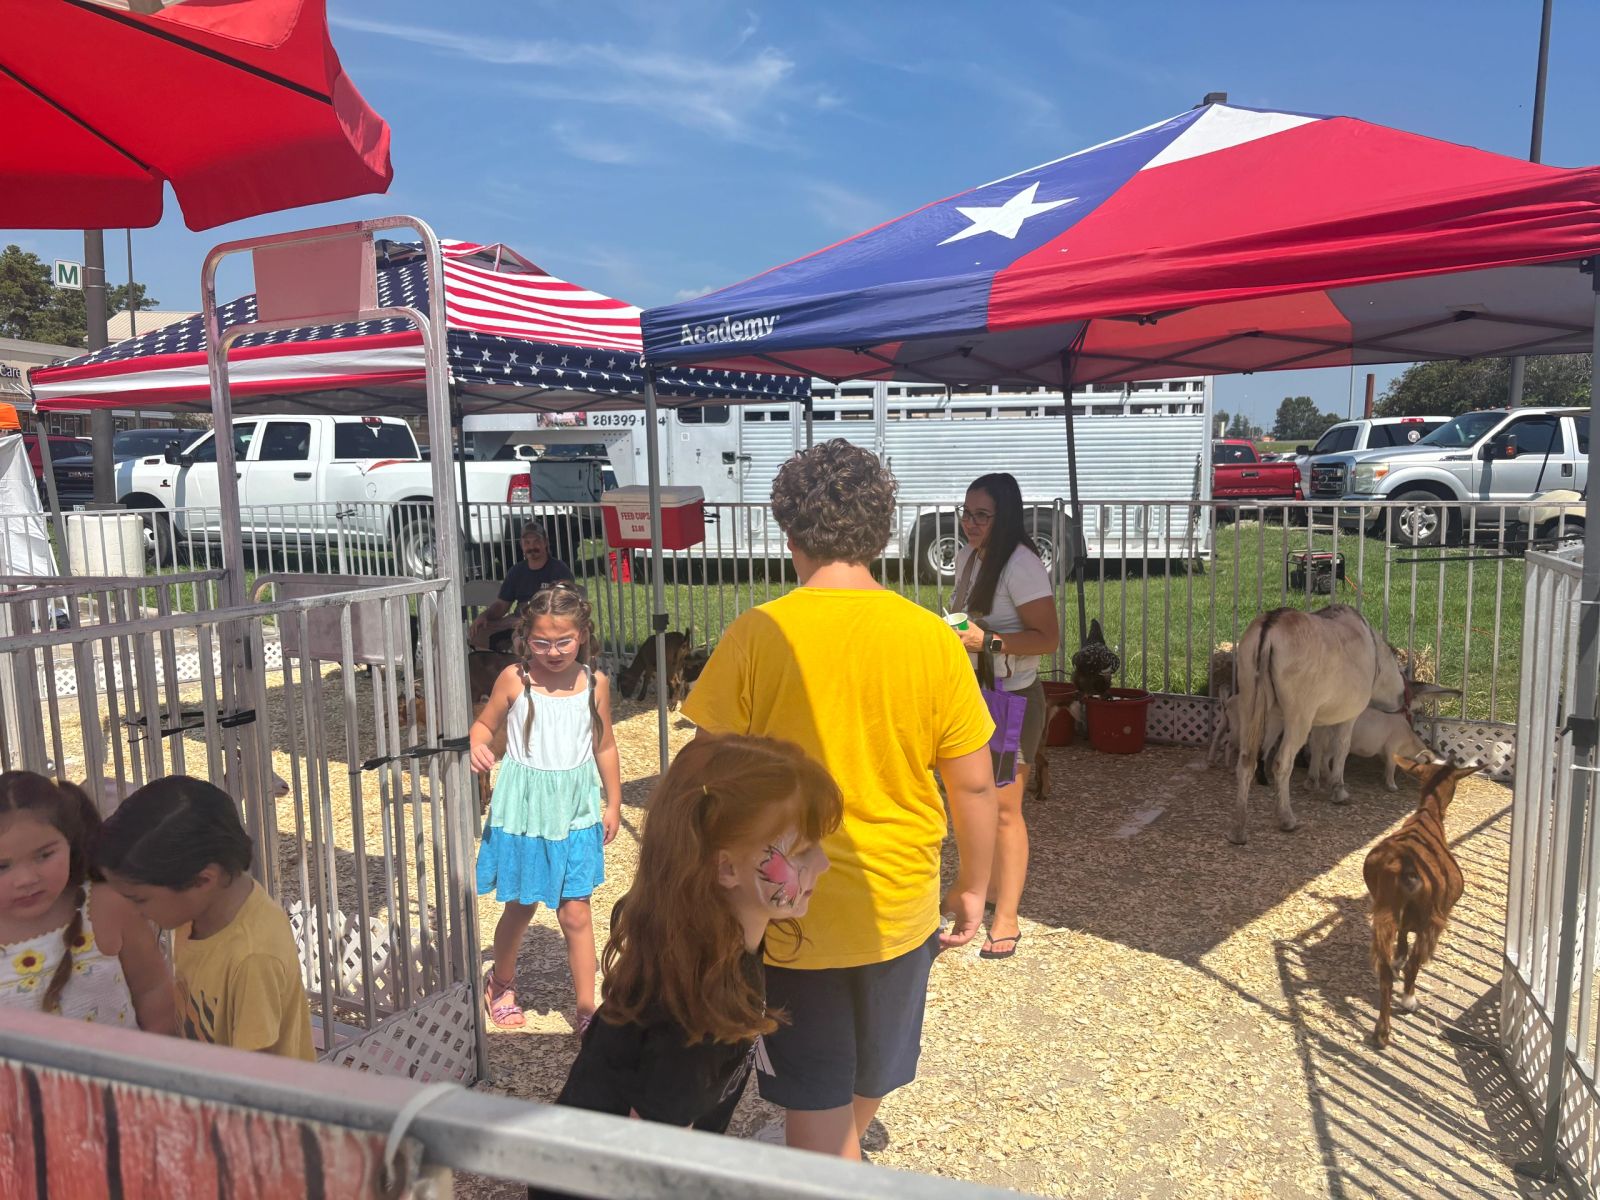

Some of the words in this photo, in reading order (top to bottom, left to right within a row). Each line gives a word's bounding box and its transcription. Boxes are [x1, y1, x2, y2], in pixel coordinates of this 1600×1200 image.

[58, 263, 78, 285] M
[681, 315, 776, 346] Academy
[0, 363, 22, 378] Care
[592, 414, 667, 426] 281-399-14
[620, 511, 635, 521] FEED
